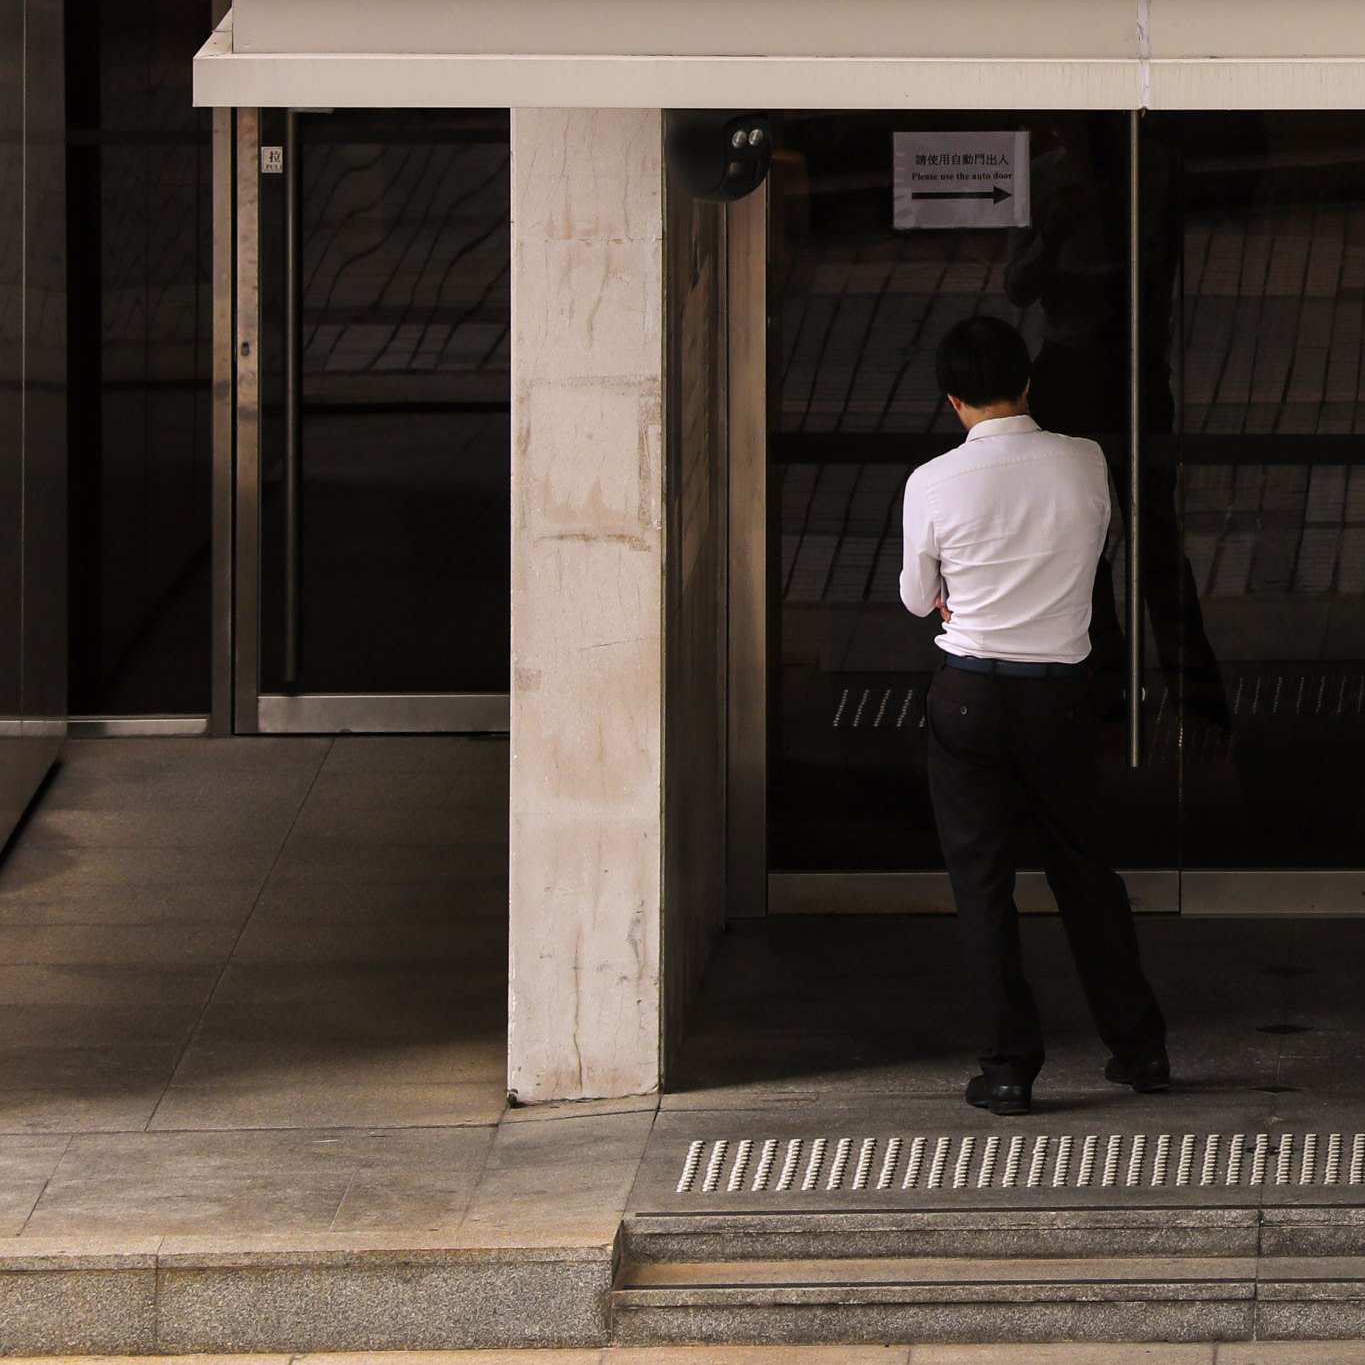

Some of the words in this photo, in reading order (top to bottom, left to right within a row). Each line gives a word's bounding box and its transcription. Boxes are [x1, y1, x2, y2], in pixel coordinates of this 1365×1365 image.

[912, 172, 938, 180] Please
[940, 172, 954, 180] use
[956, 172, 970, 180] the
[972, 172, 990, 180] auto
[993, 172, 1012, 180] door
